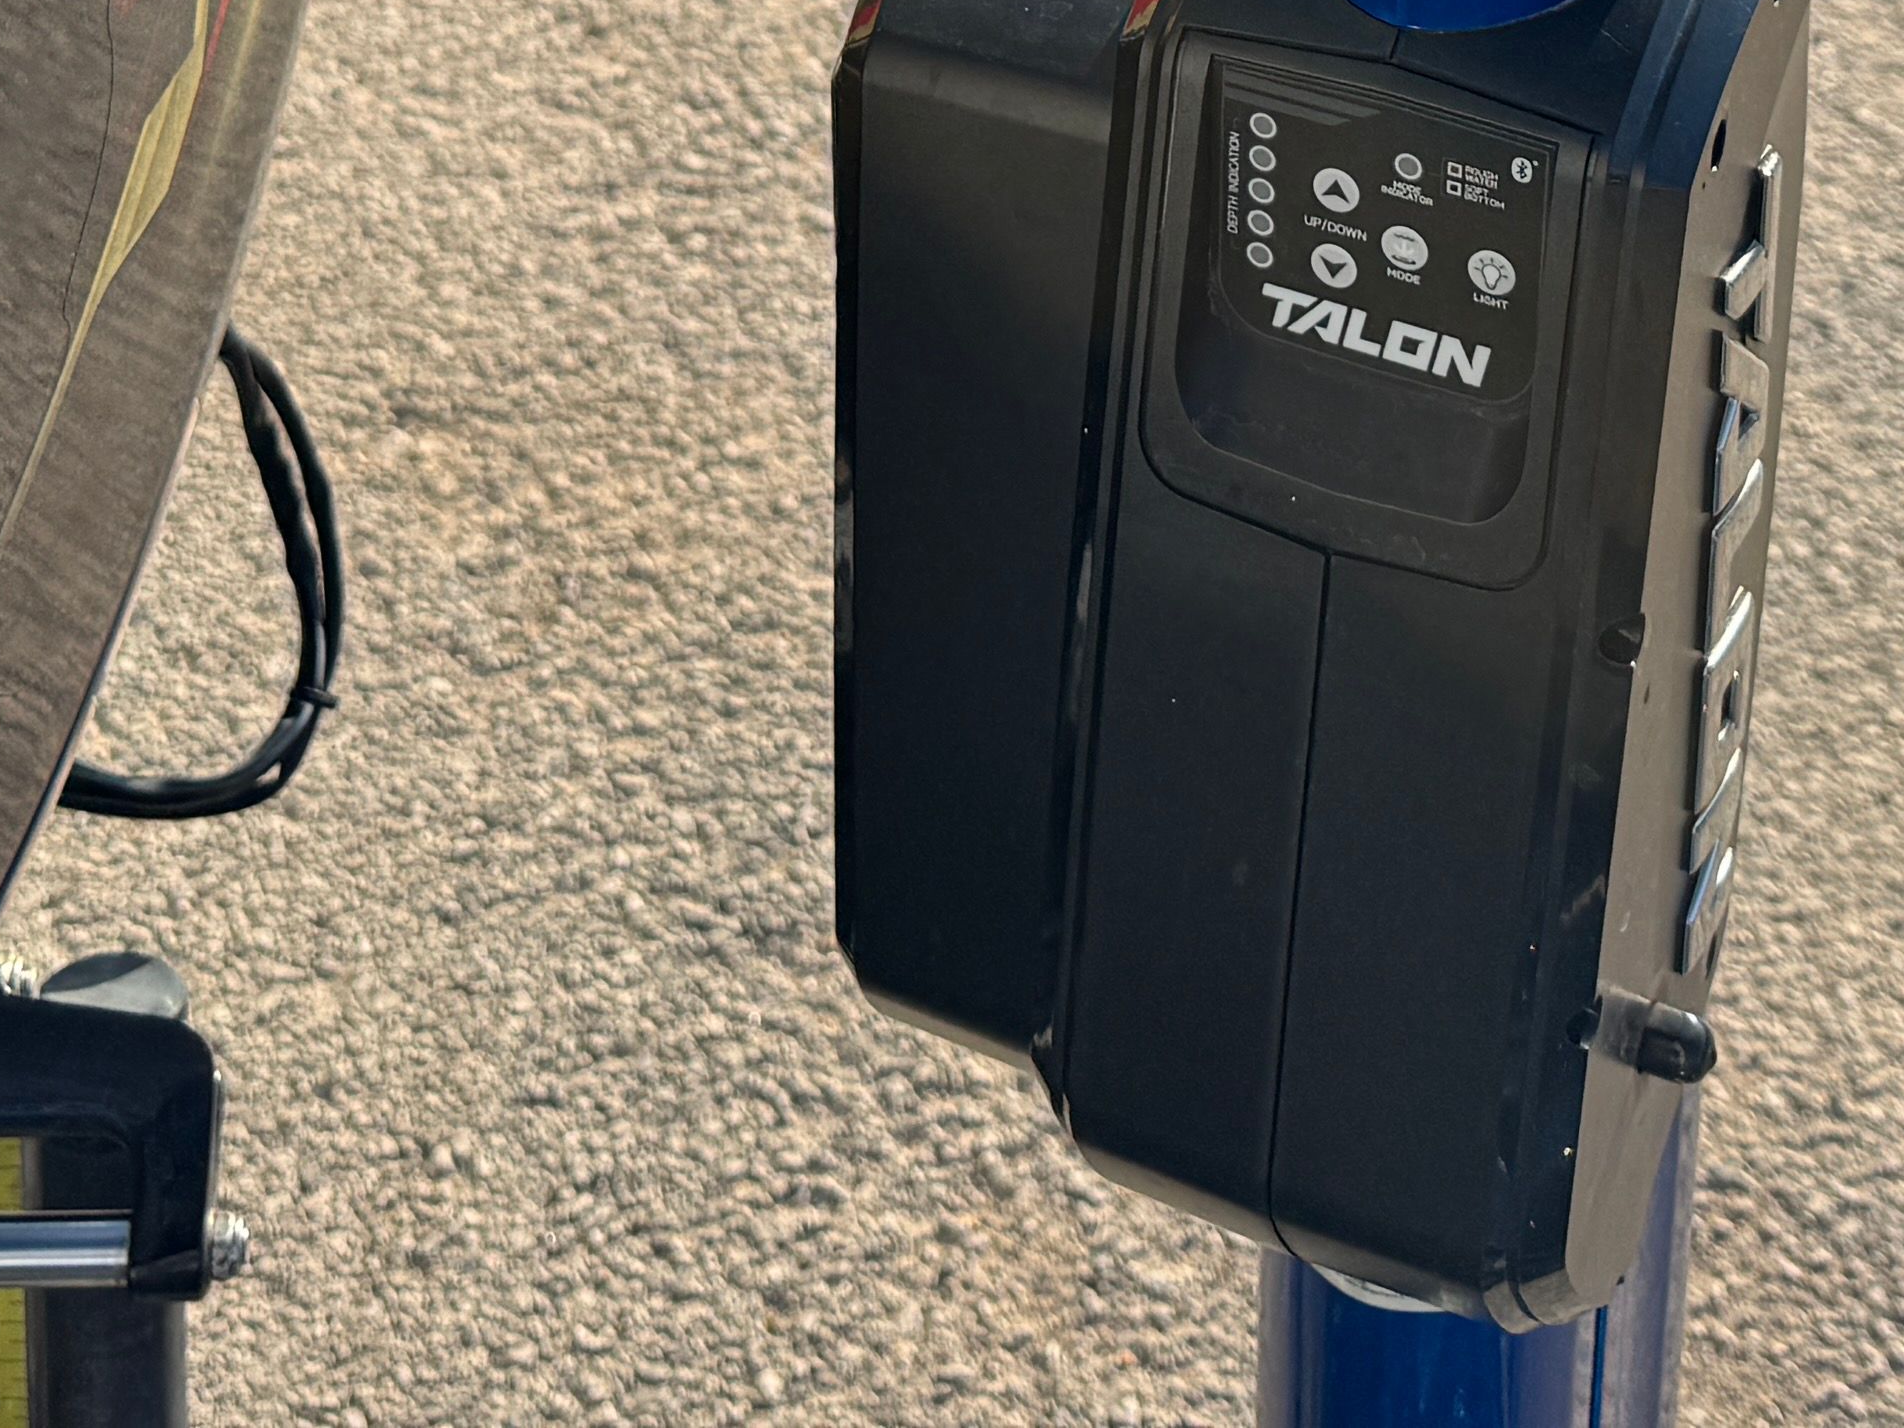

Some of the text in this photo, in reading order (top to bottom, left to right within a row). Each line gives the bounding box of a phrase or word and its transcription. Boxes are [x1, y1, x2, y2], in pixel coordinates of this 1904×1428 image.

[1226, 130, 1241, 234] DEPTH INDICATION
[1303, 213, 1368, 243] UP/DOWN
[1386, 266, 1422, 286] MODE
[1472, 291, 1510, 310] LIGHT
[1261, 282, 1493, 389] TALON
